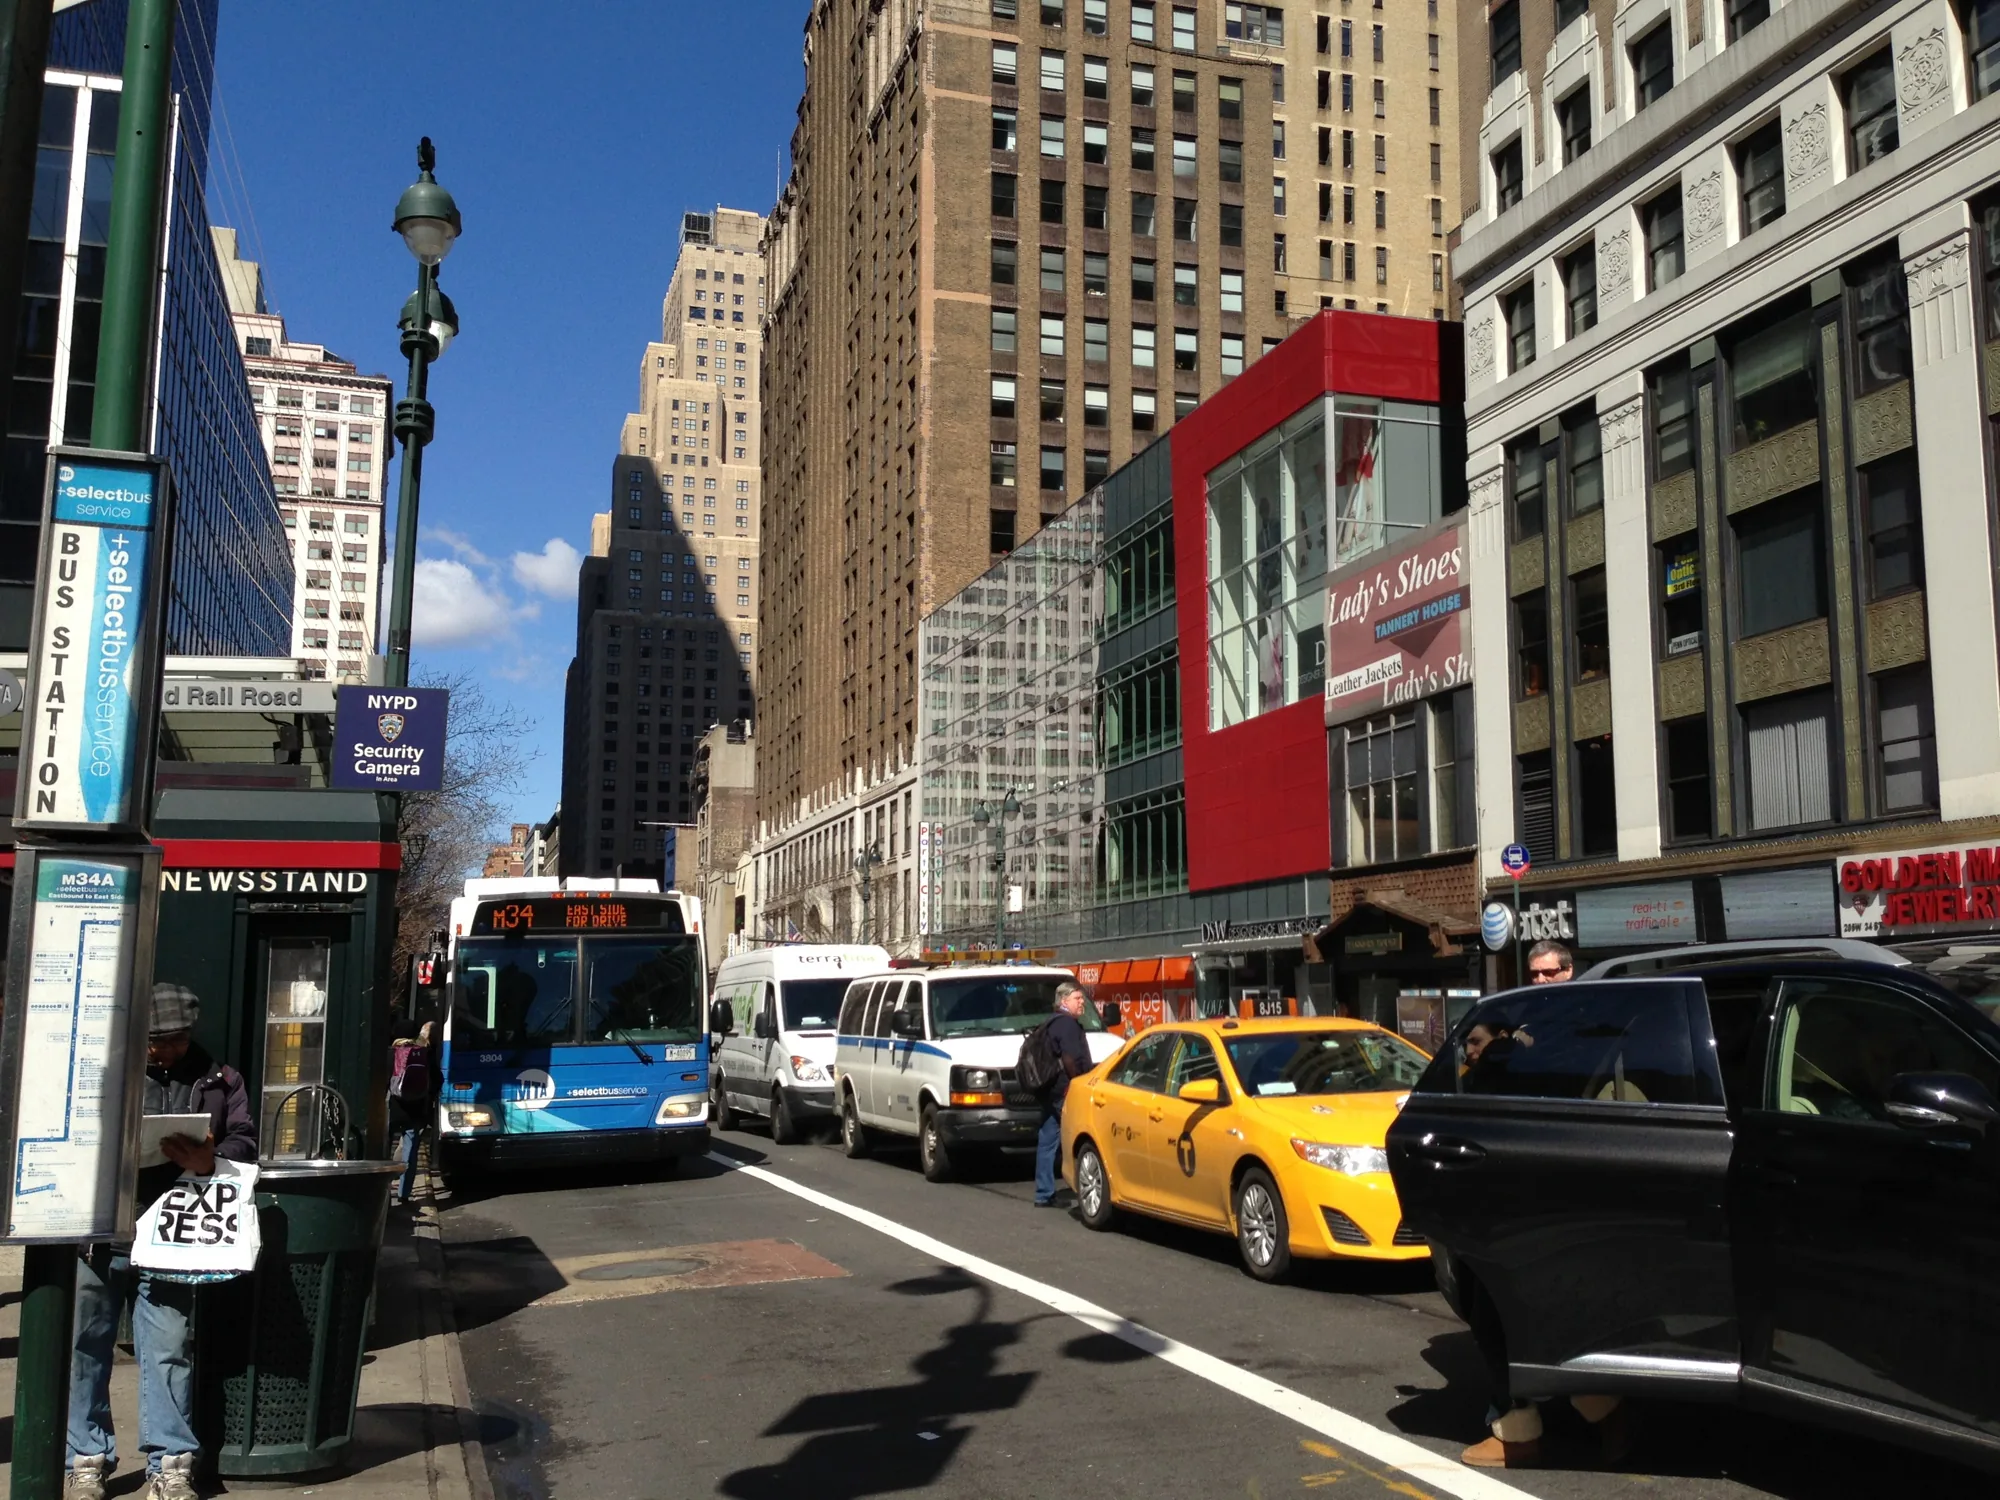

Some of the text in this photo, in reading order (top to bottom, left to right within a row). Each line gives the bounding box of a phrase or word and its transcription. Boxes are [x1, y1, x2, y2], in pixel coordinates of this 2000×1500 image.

[76, 504, 131, 518] service
[1327, 546, 1462, 627] Lady's Shoes
[1375, 594, 1461, 639] TANNERY HOUSE
[36, 532, 81, 813] BUS STATION
[1327, 659, 1403, 698] Leather Jackets
[187, 686, 232, 706] Rail
[240, 687, 302, 707] Road
[1382, 665, 1438, 708] Lady's
[367, 694, 418, 710] NYPD
[353, 742, 424, 763] Security
[354, 760, 421, 776] Camera
[921, 826, 929, 878] Party
[61, 872, 115, 887] M34A
[160, 870, 368, 893] NEWSSTAND
[1841, 850, 1962, 893] GOLDEN
[492, 903, 627, 929] M34 EAST SIDE
[920, 885, 929, 930] City
[565, 914, 627, 928] FOR DRIVE
[1201, 919, 1228, 943] DSW
[1228, 924, 1259, 940] DESIGNER
[1259, 922, 1276, 938] SHOE
[1513, 900, 1574, 942] at&t
[1081, 967, 1099, 984] FRESH
[1134, 991, 1161, 1019] joe
[1202, 999, 1225, 1015] LOVE
[1259, 1001, 1283, 1016] 8J15
[479, 1053, 503, 1063] 3804
[516, 1081, 548, 1101] MTA
[161, 1180, 238, 1214] EXP
